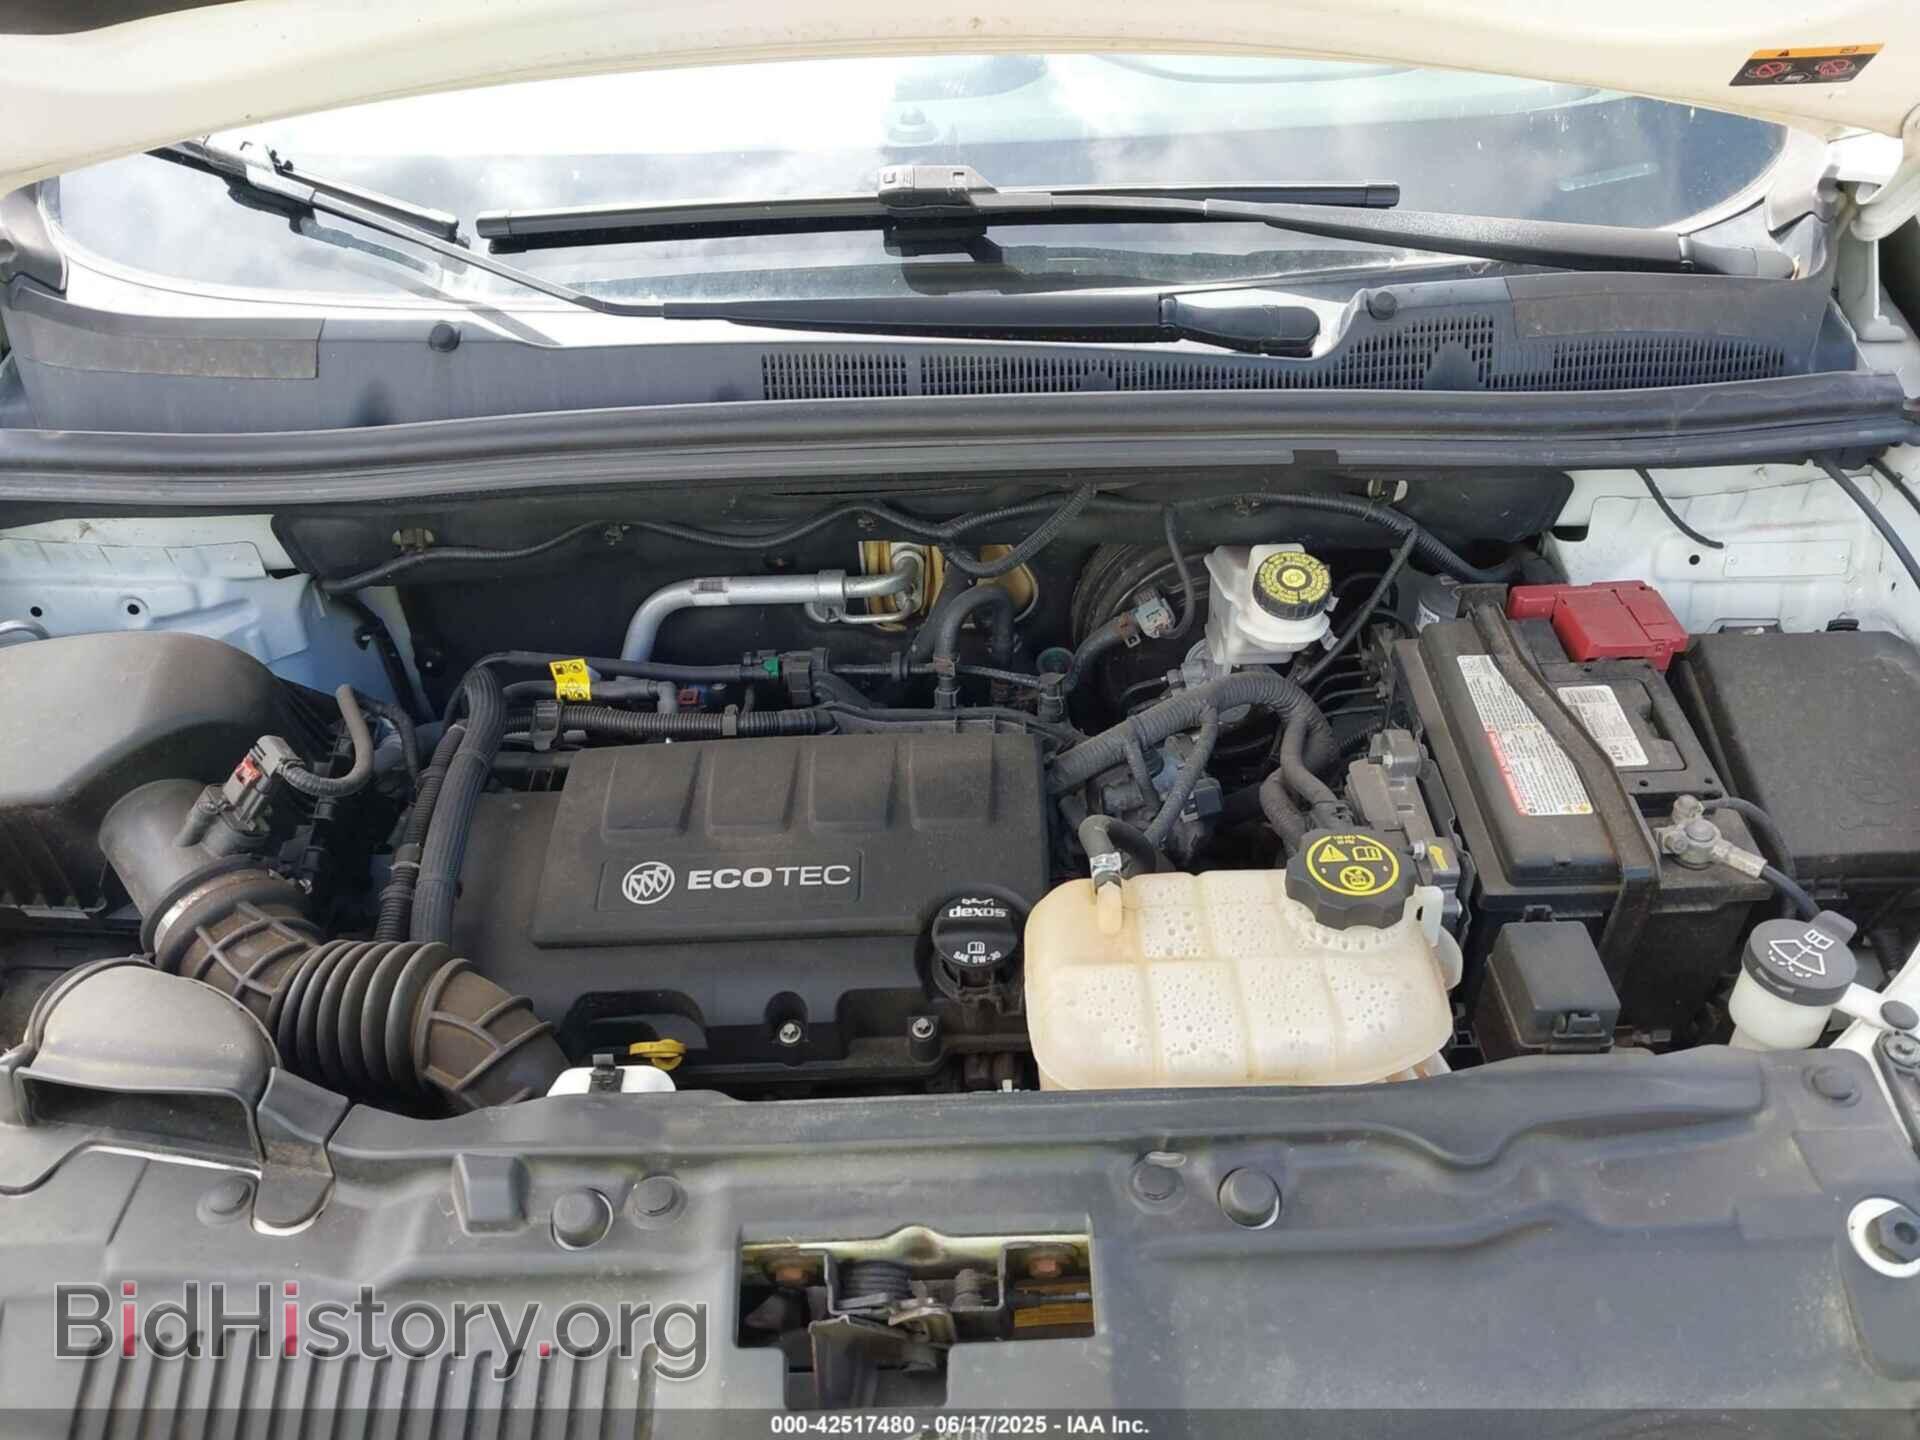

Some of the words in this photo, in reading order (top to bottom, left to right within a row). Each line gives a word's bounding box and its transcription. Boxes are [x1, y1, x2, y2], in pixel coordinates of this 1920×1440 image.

[687, 864, 851, 891] ECOTEC
[948, 905, 1009, 918] dexos
[953, 950, 970, 963] SAE
